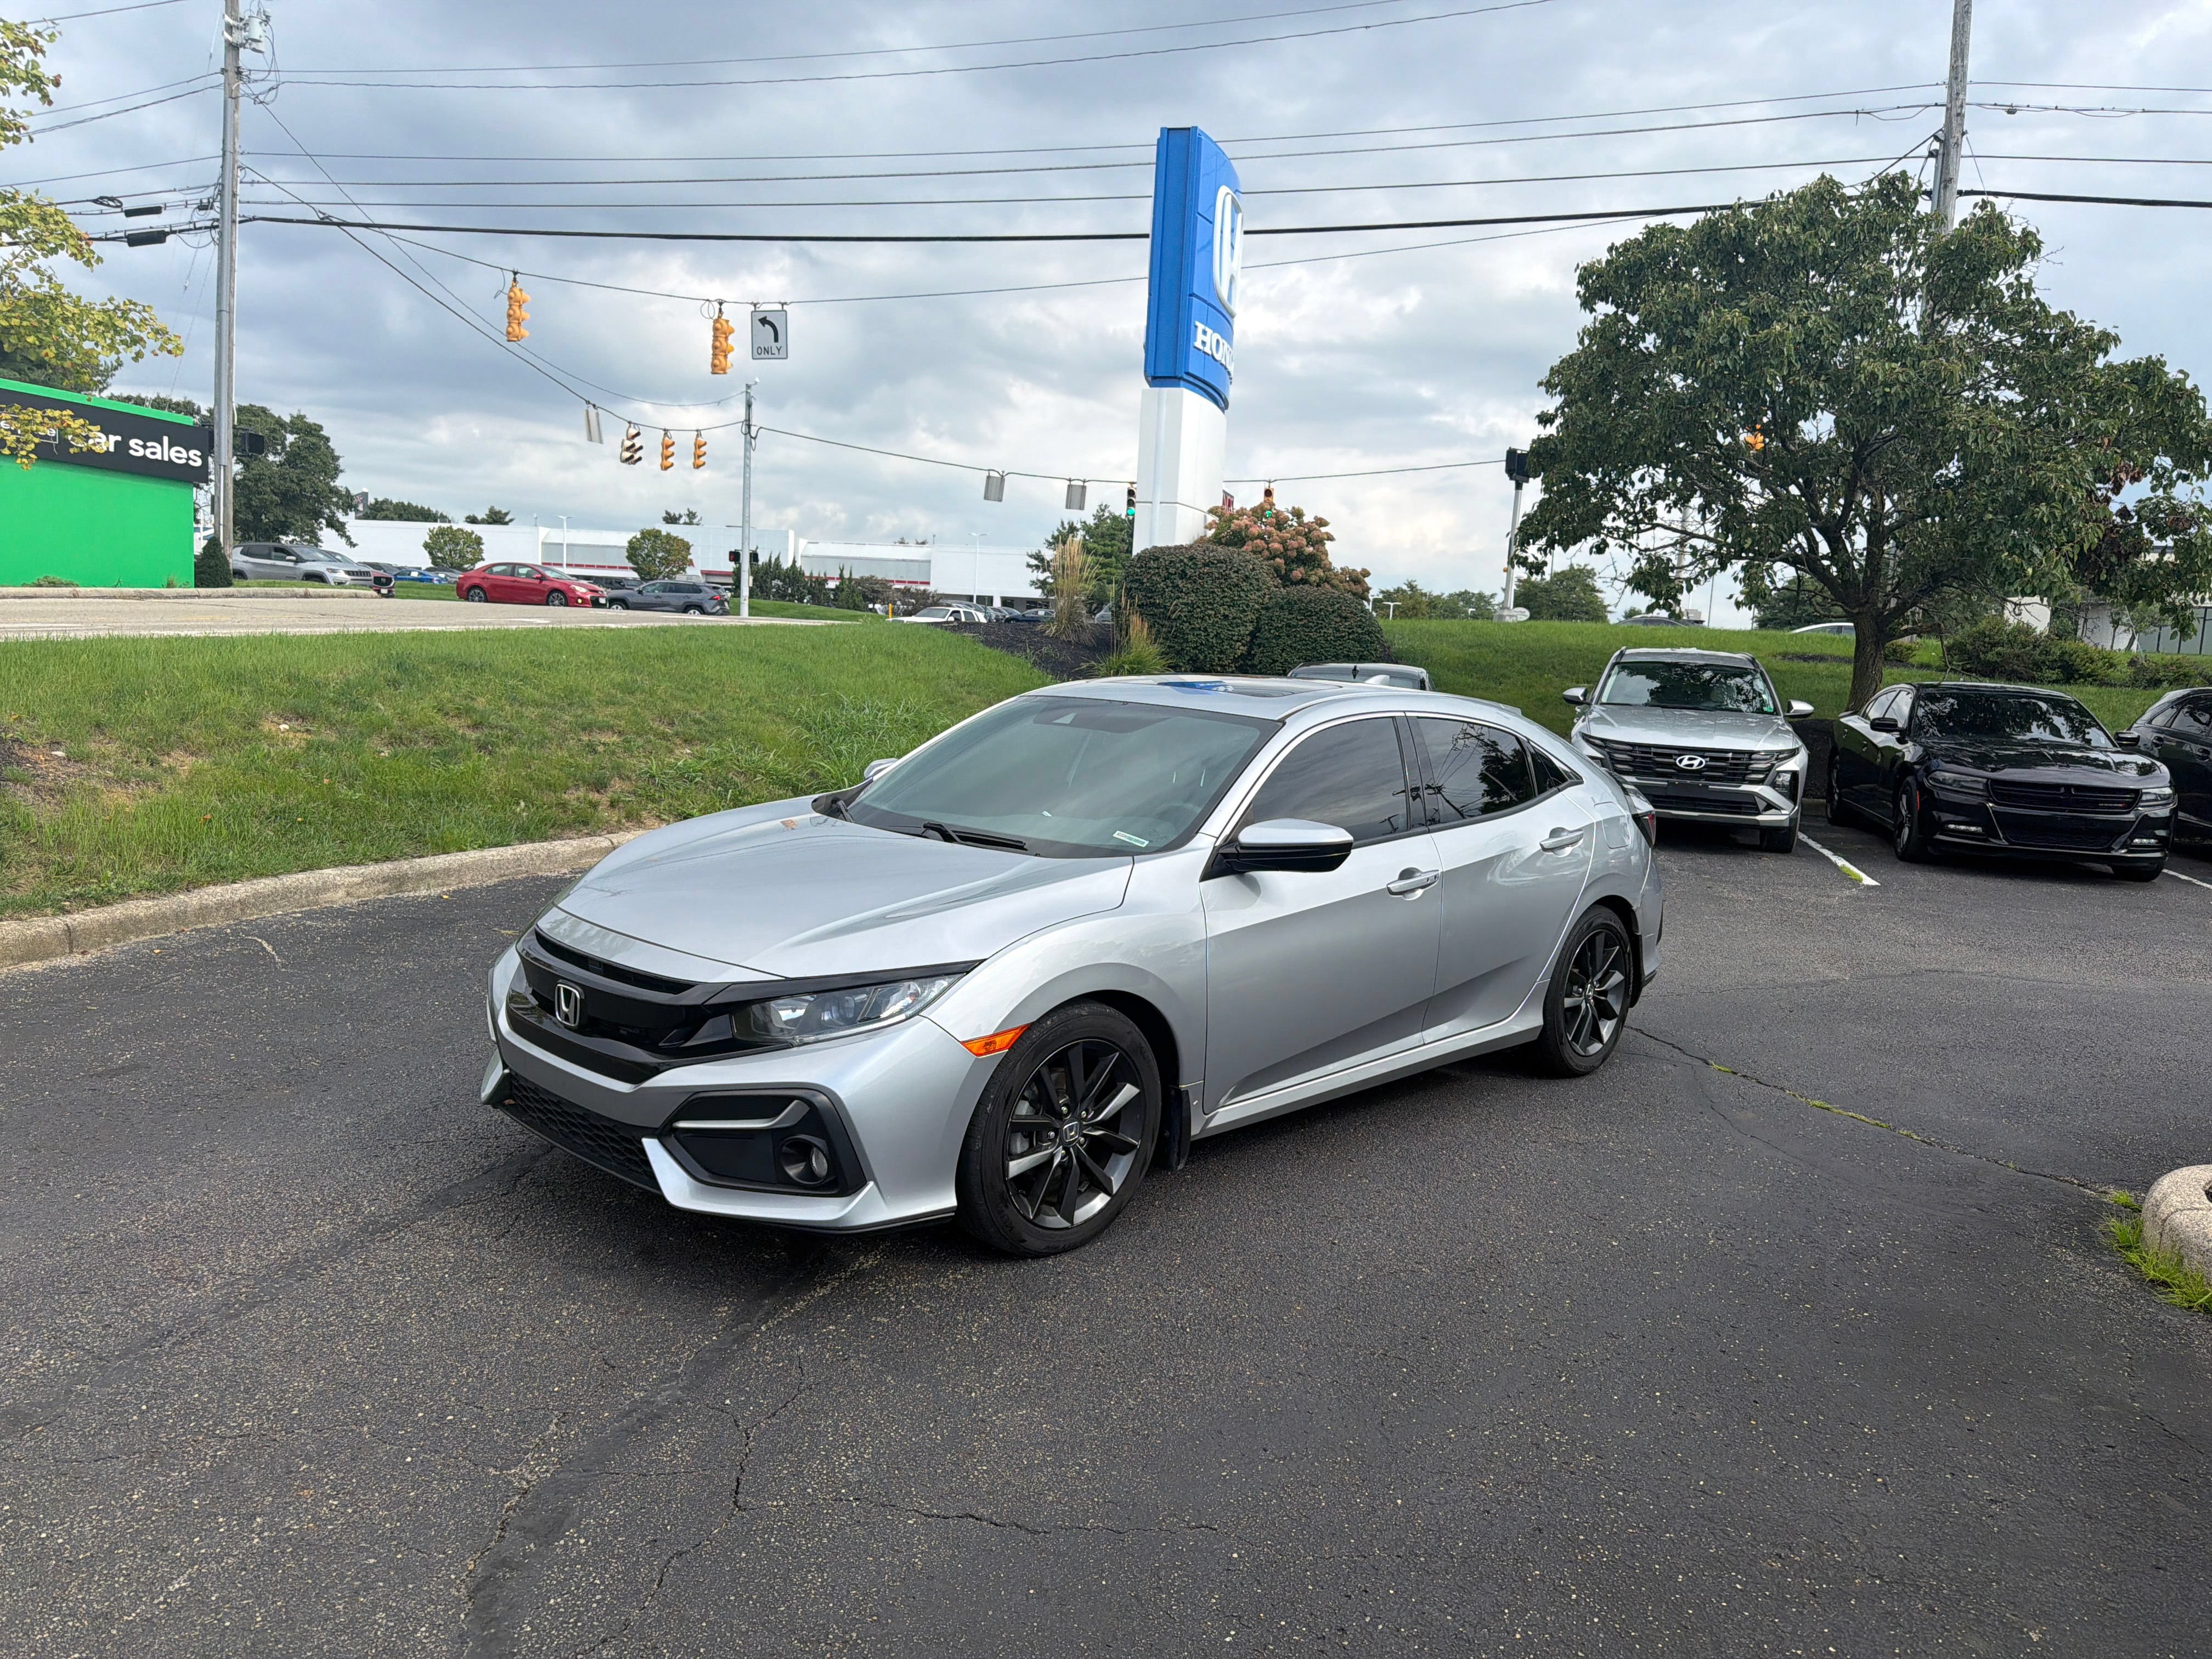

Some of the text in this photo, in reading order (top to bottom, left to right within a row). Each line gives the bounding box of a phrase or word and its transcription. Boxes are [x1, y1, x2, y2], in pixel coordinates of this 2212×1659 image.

[757, 346, 782, 356] ONLY
[1193, 320, 1234, 377] HON
[128, 436, 202, 467] sales
